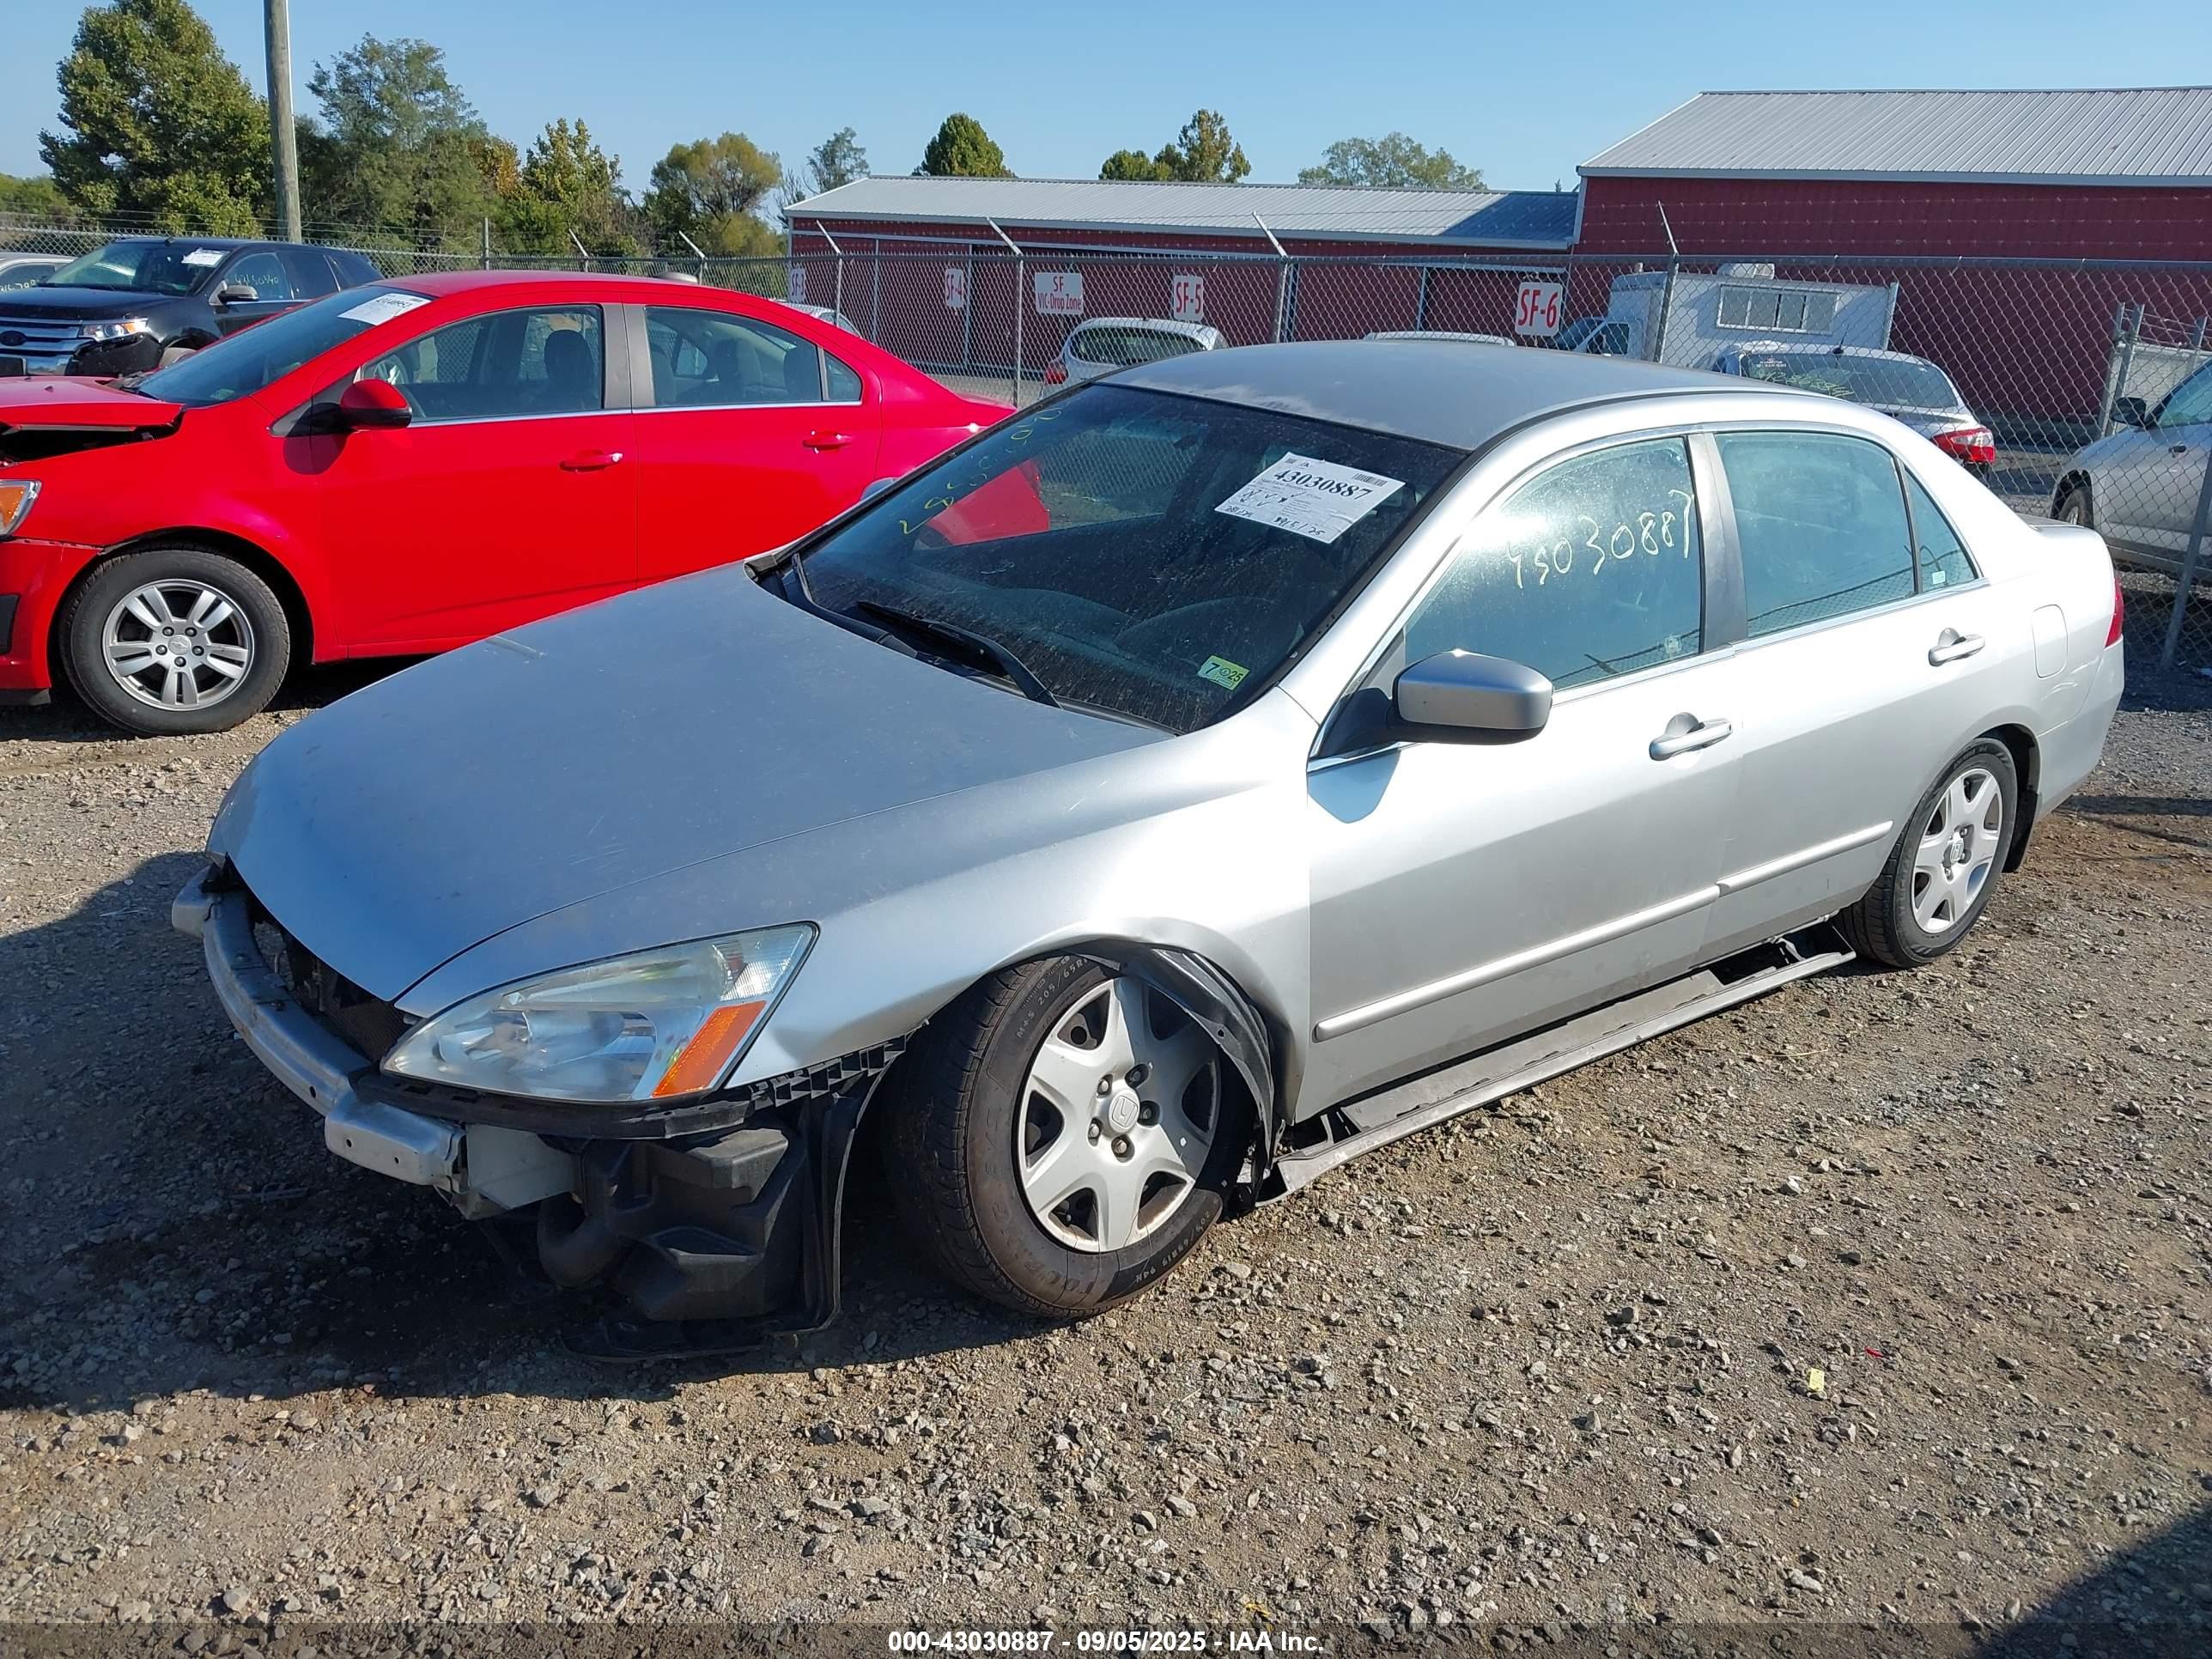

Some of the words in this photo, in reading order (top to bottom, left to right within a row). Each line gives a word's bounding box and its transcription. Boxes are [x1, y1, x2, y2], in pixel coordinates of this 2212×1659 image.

[791, 273, 805, 296] SF-3
[945, 273, 963, 301] SF-4
[1053, 275, 1065, 293] SF
[1176, 281, 1202, 314] SF-5
[1066, 293, 1082, 310] Zone
[1517, 289, 1559, 328] SF-6
[1273, 469, 1373, 500] 43030887
[1206, 662, 1220, 675] 7
[1227, 671, 1243, 683] 25
[1037, 957, 1089, 1006] 205/65R1
